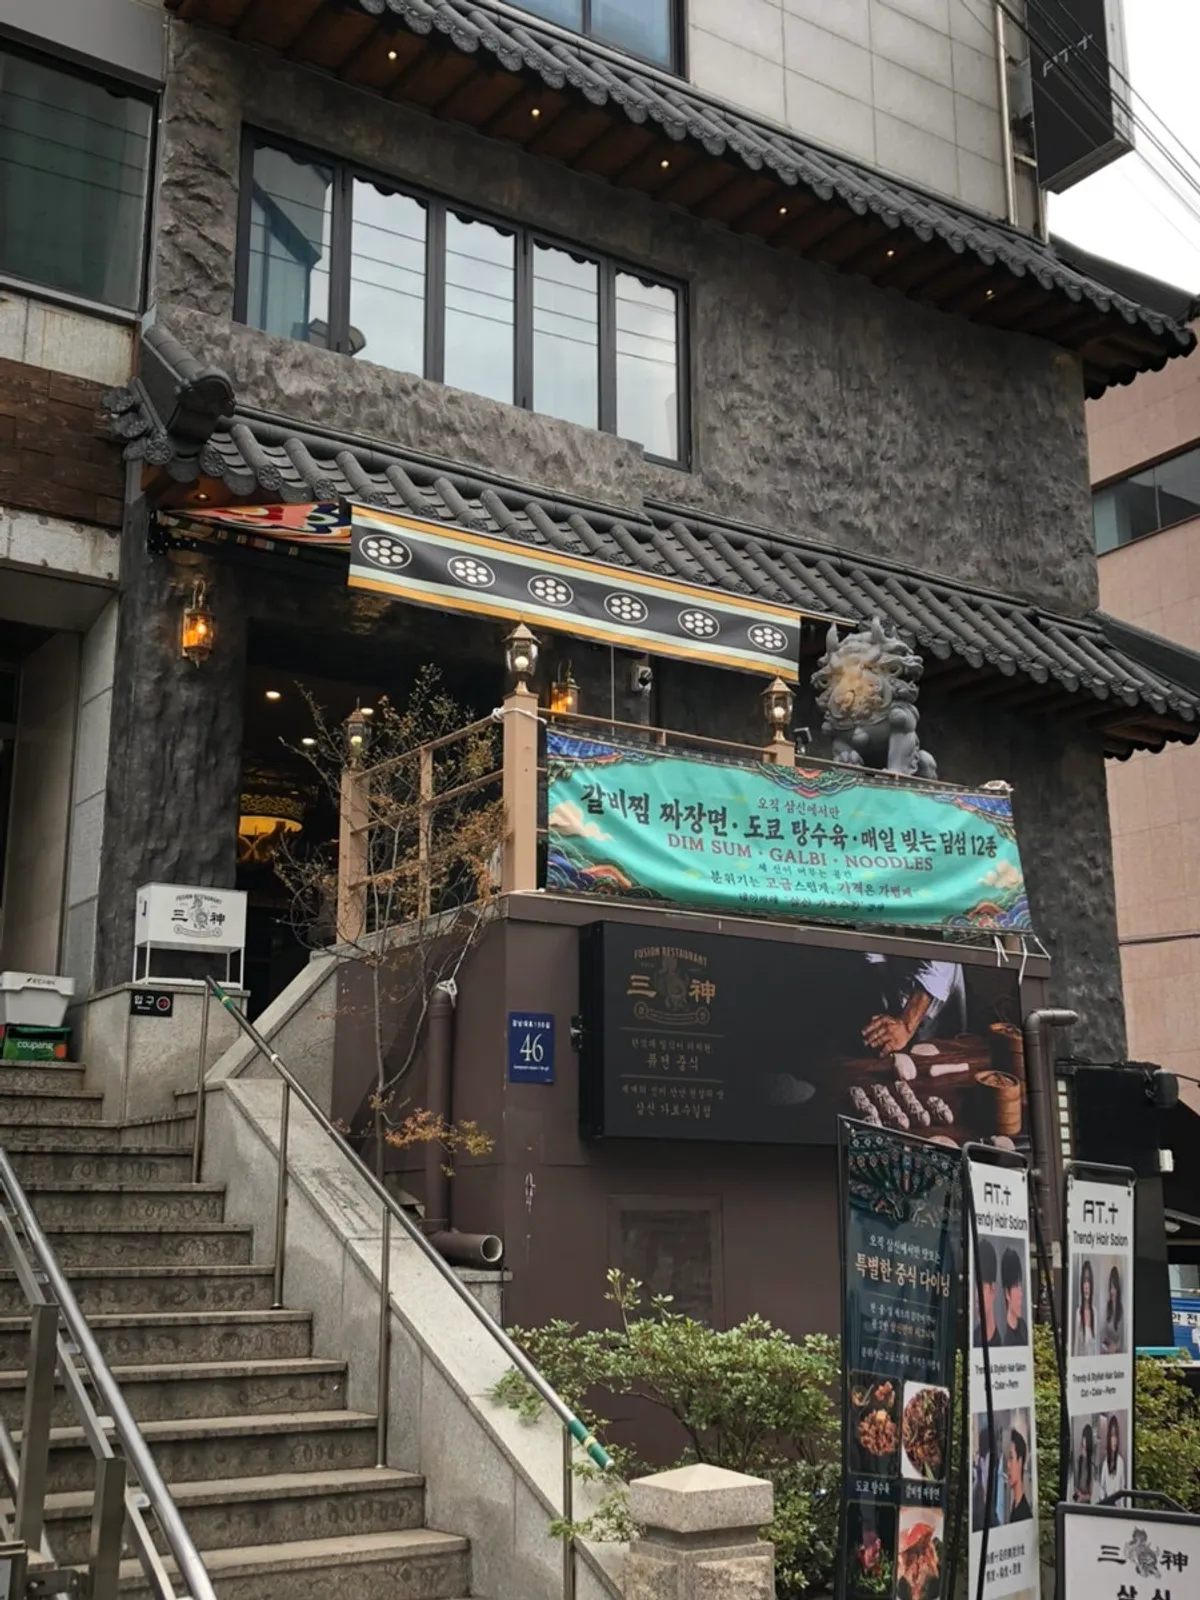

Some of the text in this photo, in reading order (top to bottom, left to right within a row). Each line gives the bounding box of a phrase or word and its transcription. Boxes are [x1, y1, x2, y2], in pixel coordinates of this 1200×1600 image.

[757, 797, 840, 819] 오직 삼신에서만
[581, 783, 649, 825] 갈비찜
[743, 815, 785, 840] 도쿄
[791, 819, 848, 851] 탕수육
[861, 827, 897, 853] 매일
[901, 828, 936, 854] 빚는
[938, 830, 966, 857] 딤섬
[971, 835, 998, 859] 12종
[668, 833, 933, 871] DIM SUM GALBI NOODLES
[710, 870, 760, 888] 분위기는
[839, 880, 876, 896] 가격은
[879, 884, 912, 898] 가볍게
[634, 946, 707, 967] FUSION RESTAURANT
[17, 1040, 54, 1051] coupang
[520, 1033, 544, 1062] 46
[676, 1055, 698, 1072] 중식
[975, 1211, 1028, 1232] rendy Hair Salon
[869, 1235, 884, 1250] 오직
[1074, 1230, 1128, 1249] Trendy Hair Salon
[855, 1252, 950, 1298] 특별한 중식 다이닝
